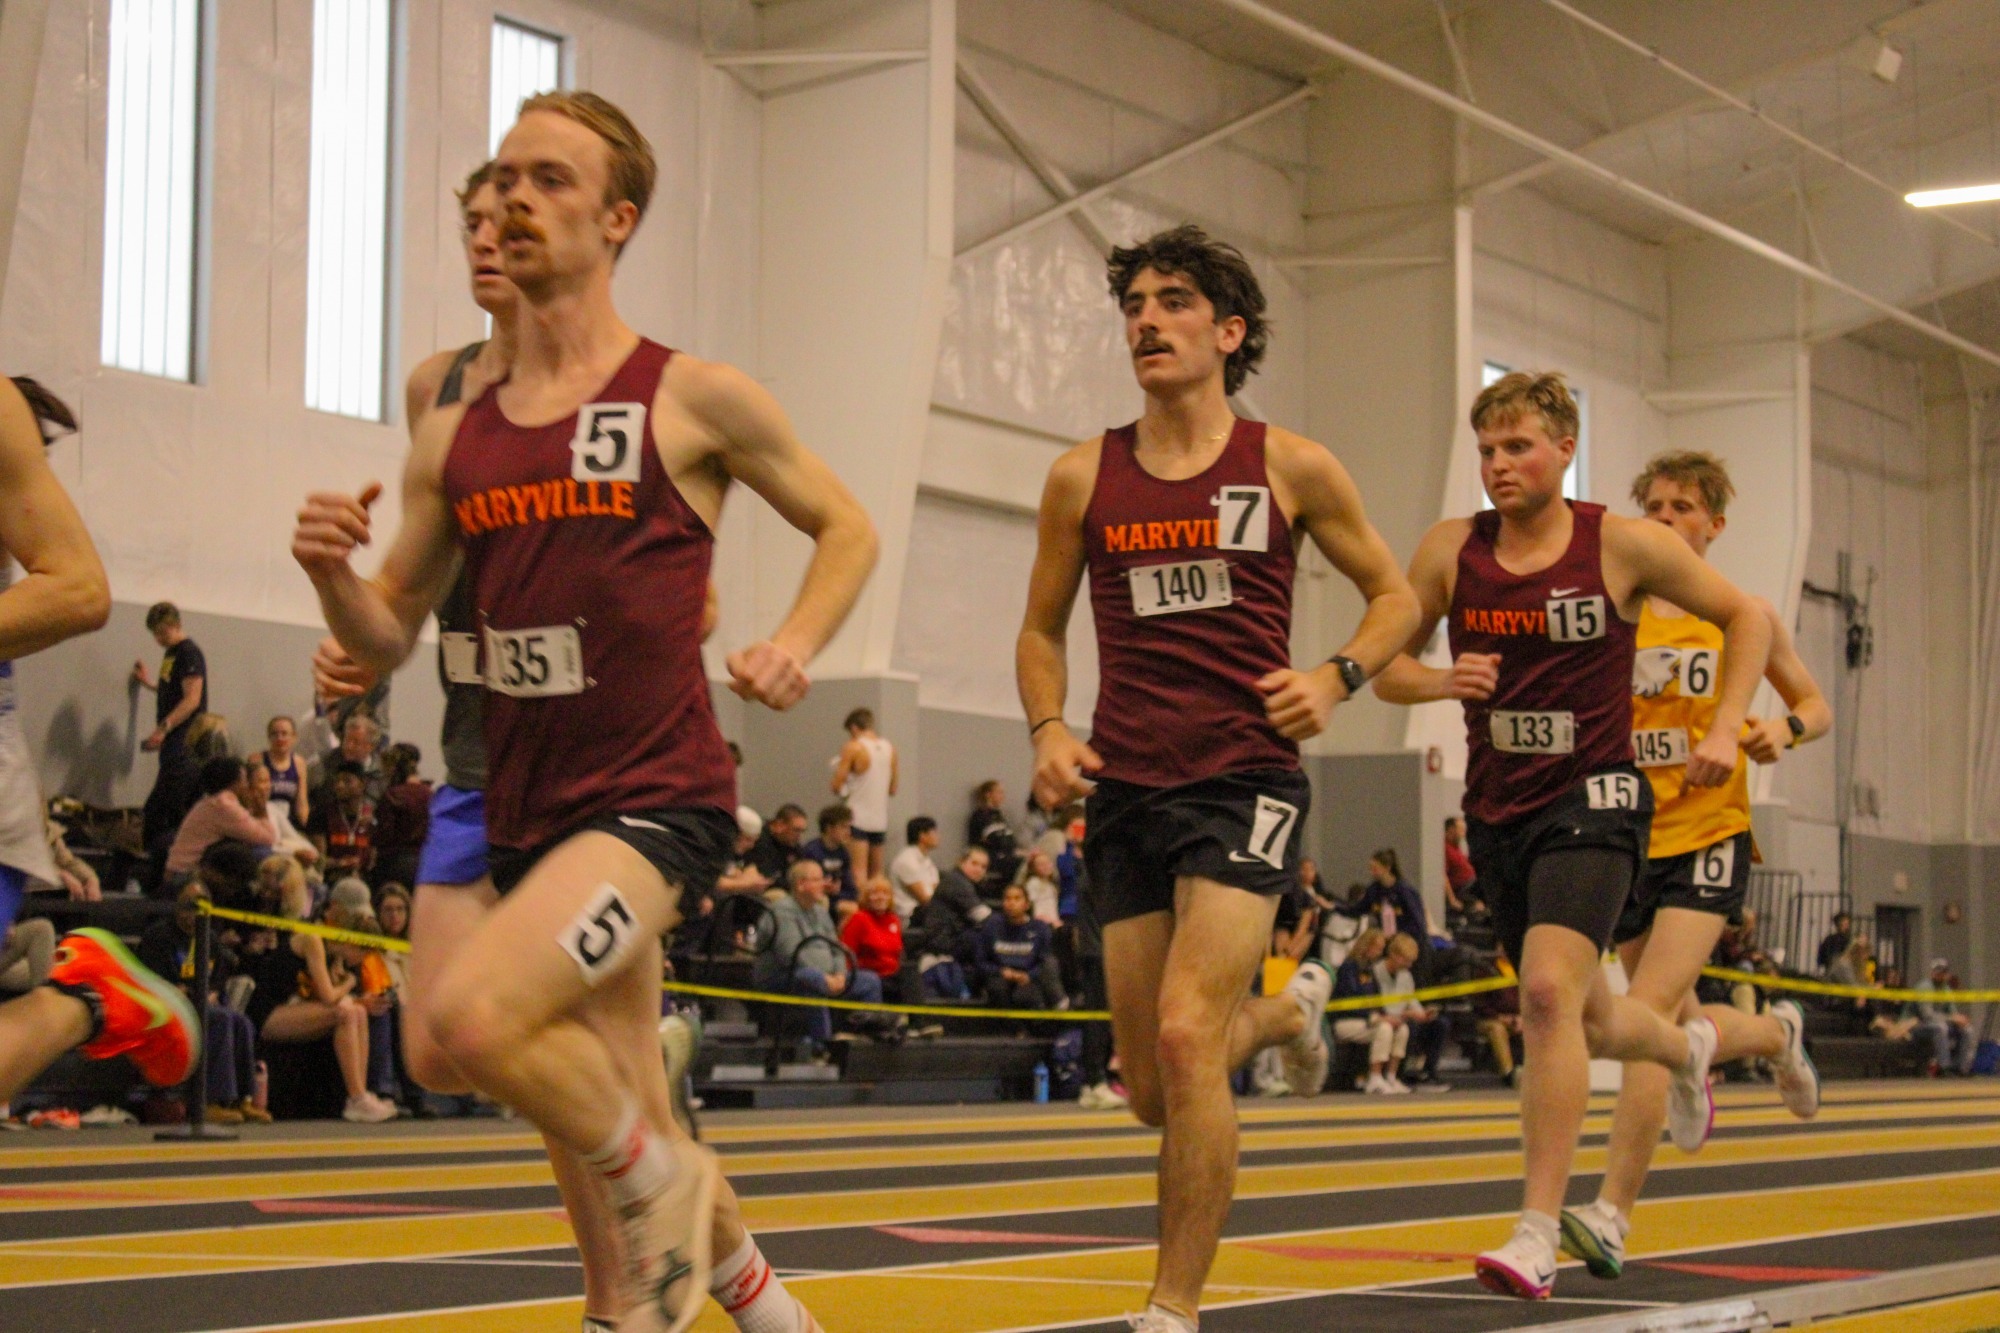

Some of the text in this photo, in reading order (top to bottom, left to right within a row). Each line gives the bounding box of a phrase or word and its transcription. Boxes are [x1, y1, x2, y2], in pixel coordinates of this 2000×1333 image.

[585, 411, 628, 472] 5
[455, 478, 636, 536] MARYVILLE
[1227, 491, 1260, 545] 7
[1152, 564, 1207, 607] 140
[1552, 600, 1597, 640] 15
[1688, 651, 1710, 695] 6
[1509, 716, 1554, 748] 133
[1636, 731, 1673, 762] 145
[1592, 776, 1632, 810] 15
[1261, 804, 1292, 855] 7
[1703, 843, 1726, 882] 6
[578, 896, 631, 968] 5
